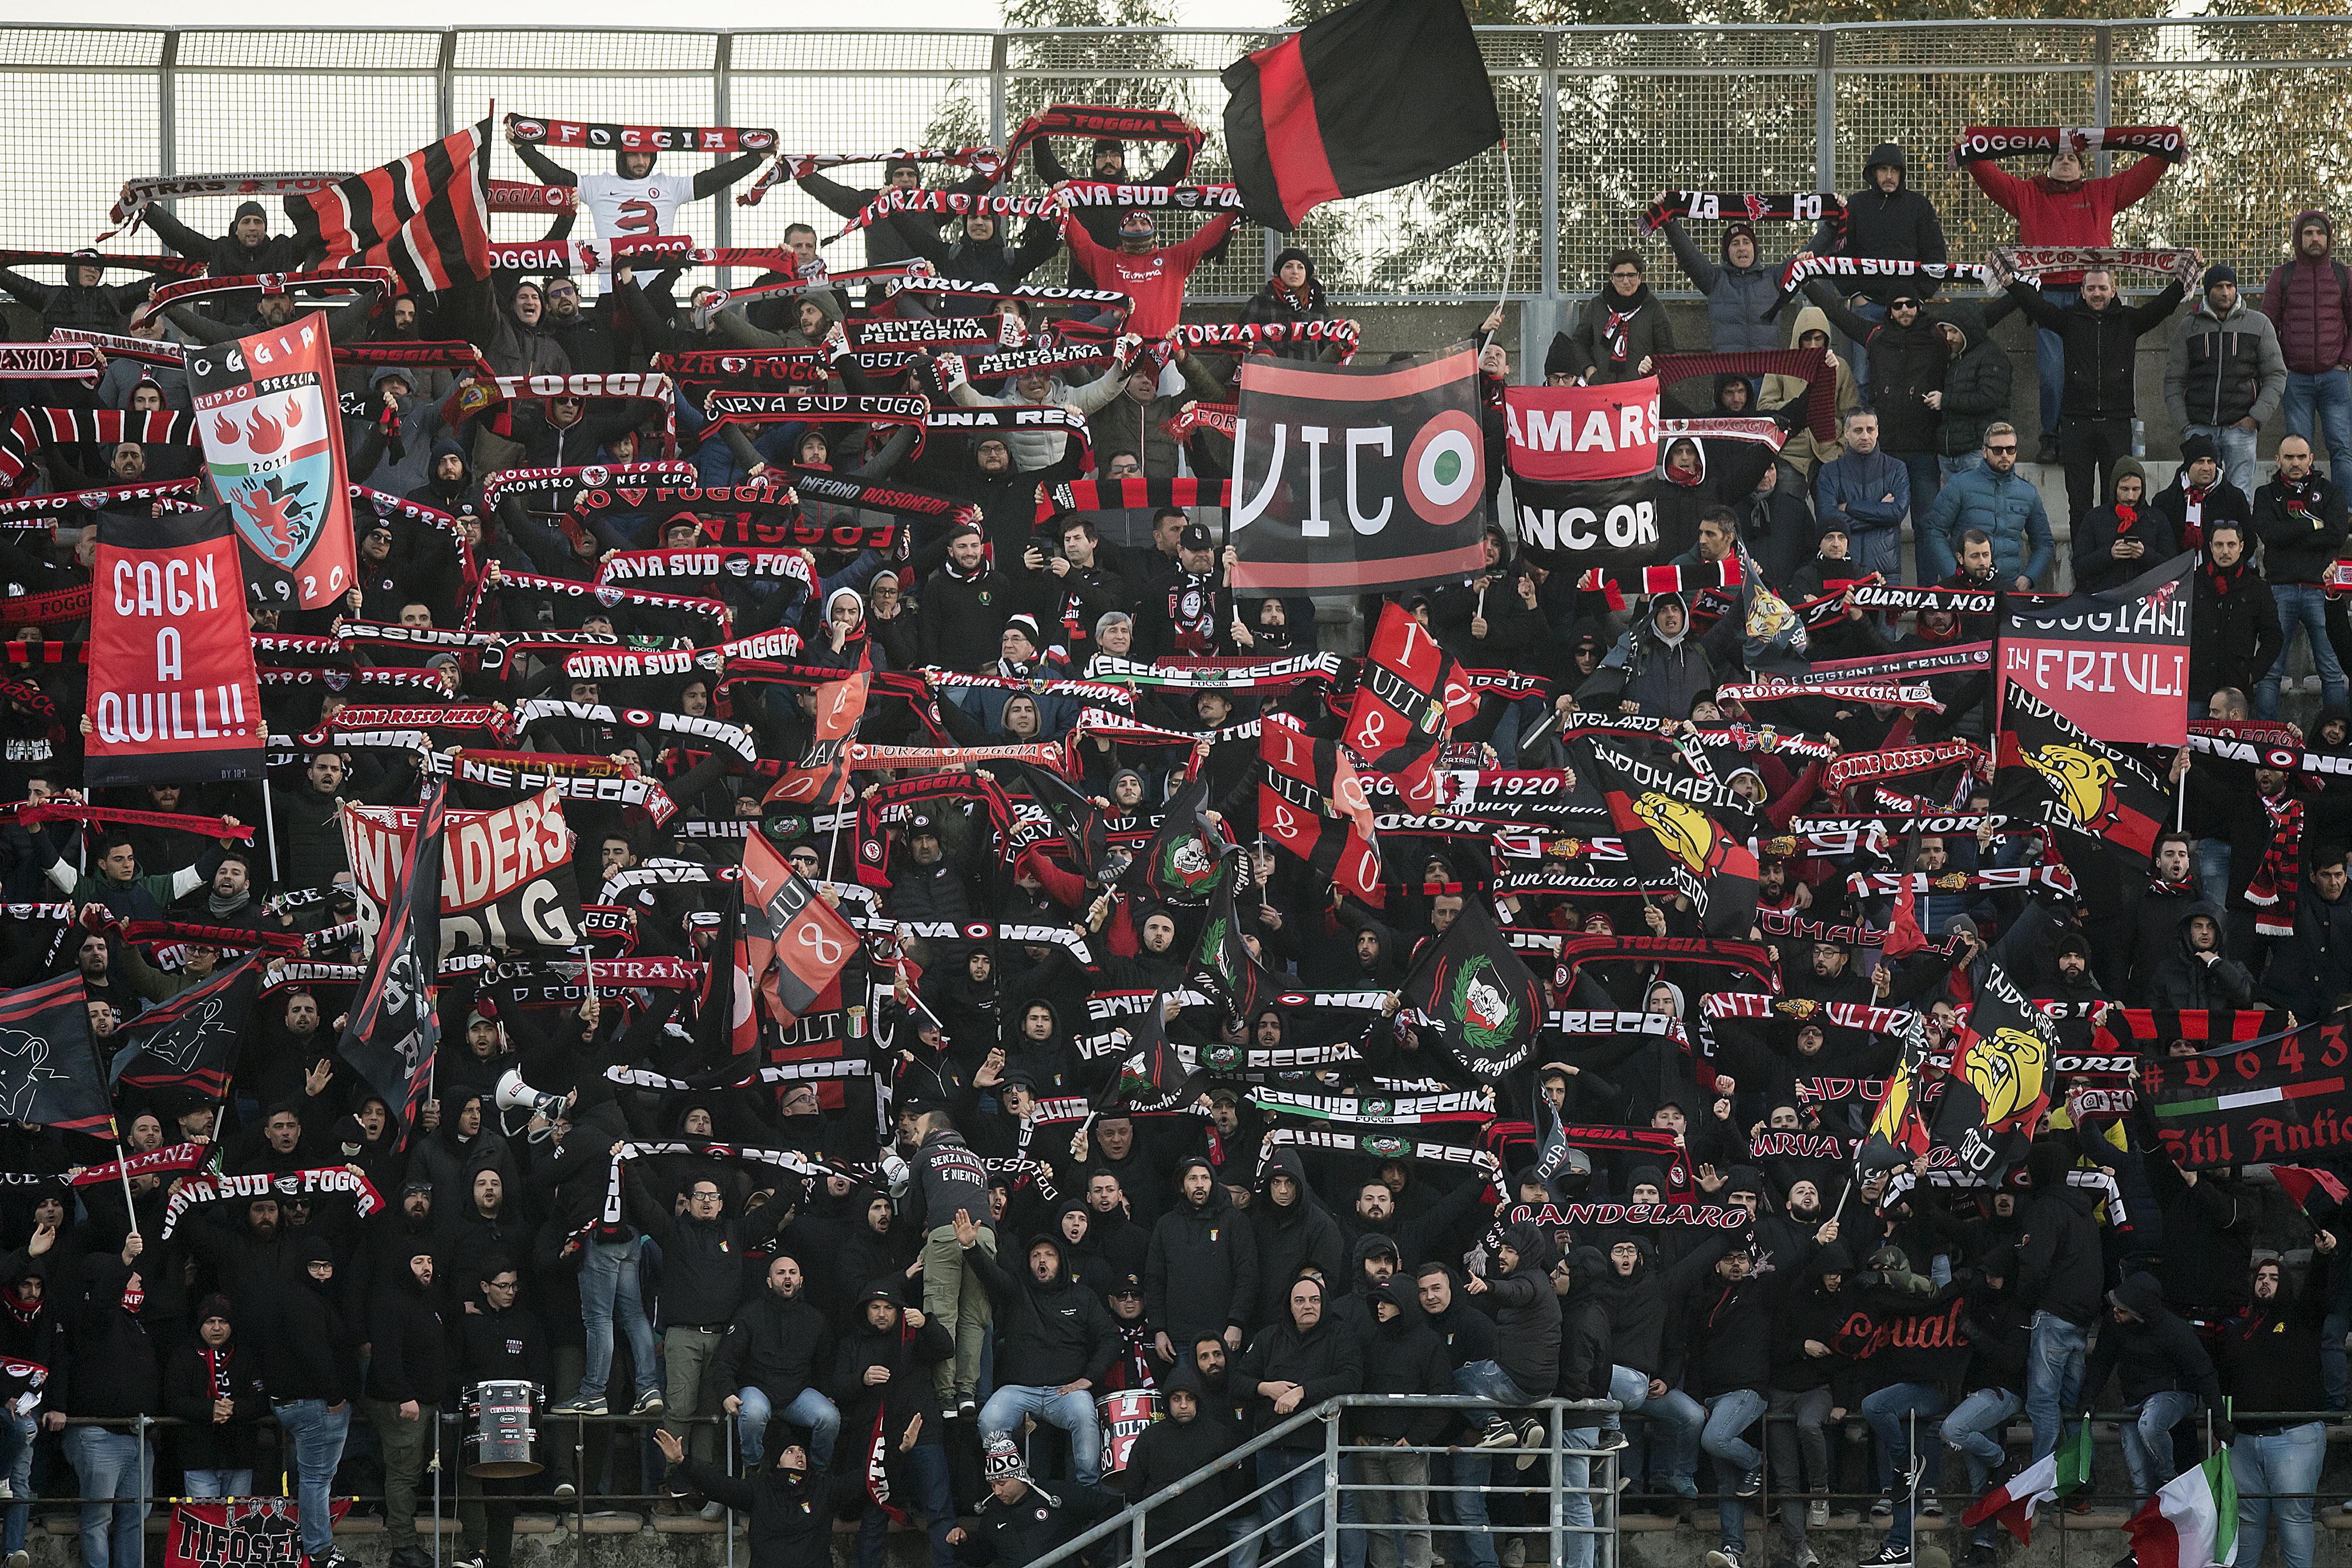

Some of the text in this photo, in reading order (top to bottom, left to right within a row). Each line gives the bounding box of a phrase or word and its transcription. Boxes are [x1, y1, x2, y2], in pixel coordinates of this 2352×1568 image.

[560, 125, 726, 147] FOGGIA
[2116, 131, 2179, 152] 1920
[1061, 185, 1168, 206] RVA SUD
[490, 249, 563, 269] OGGIA
[1862, 258, 1915, 276] SUD
[1013, 285, 1124, 302] NORD
[859, 327, 988, 344] PELLEGRINA
[1176, 324, 1254, 347] FORZA
[186, 325, 315, 377] OGGIA
[261, 372, 316, 392] BRESCIA
[193, 385, 249, 412] GRUPPO
[797, 397, 848, 413] SUD
[253, 455, 288, 473] 2017
[616, 474, 648, 484] NEL
[797, 475, 951, 515] INFERNO ROSSONERO
[670, 554, 720, 575] SUD
[114, 553, 218, 616] CAGN
[250, 565, 343, 601] 1920
[1853, 587, 1941, 610] CURVA
[337, 624, 490, 646] ESSUNA
[156, 627, 182, 682] A
[566, 633, 800, 678] CURVA SUD FOGGIA
[2006, 647, 2030, 670] IN
[1044, 680, 1131, 707] Amore
[97, 683, 246, 744] QUILL!!
[390, 709, 492, 724] ROSSO NERO
[658, 712, 757, 762] NORD
[870, 744, 937, 758] FORZA
[1883, 748, 1933, 771] ROSSO
[2187, 734, 2261, 765] RVA
[462, 761, 512, 787] NE
[883, 775, 973, 798] FOGGIA
[1491, 777, 1559, 795] 1920
[999, 924, 1093, 964] NORD
[1703, 992, 1774, 1018] ANTI
[1472, 1045, 1529, 1077] Regime
[2055, 1056, 2135, 1072] ORD
[930, 1154, 961, 1168] SENZA
[219, 1174, 268, 1196] SUD
